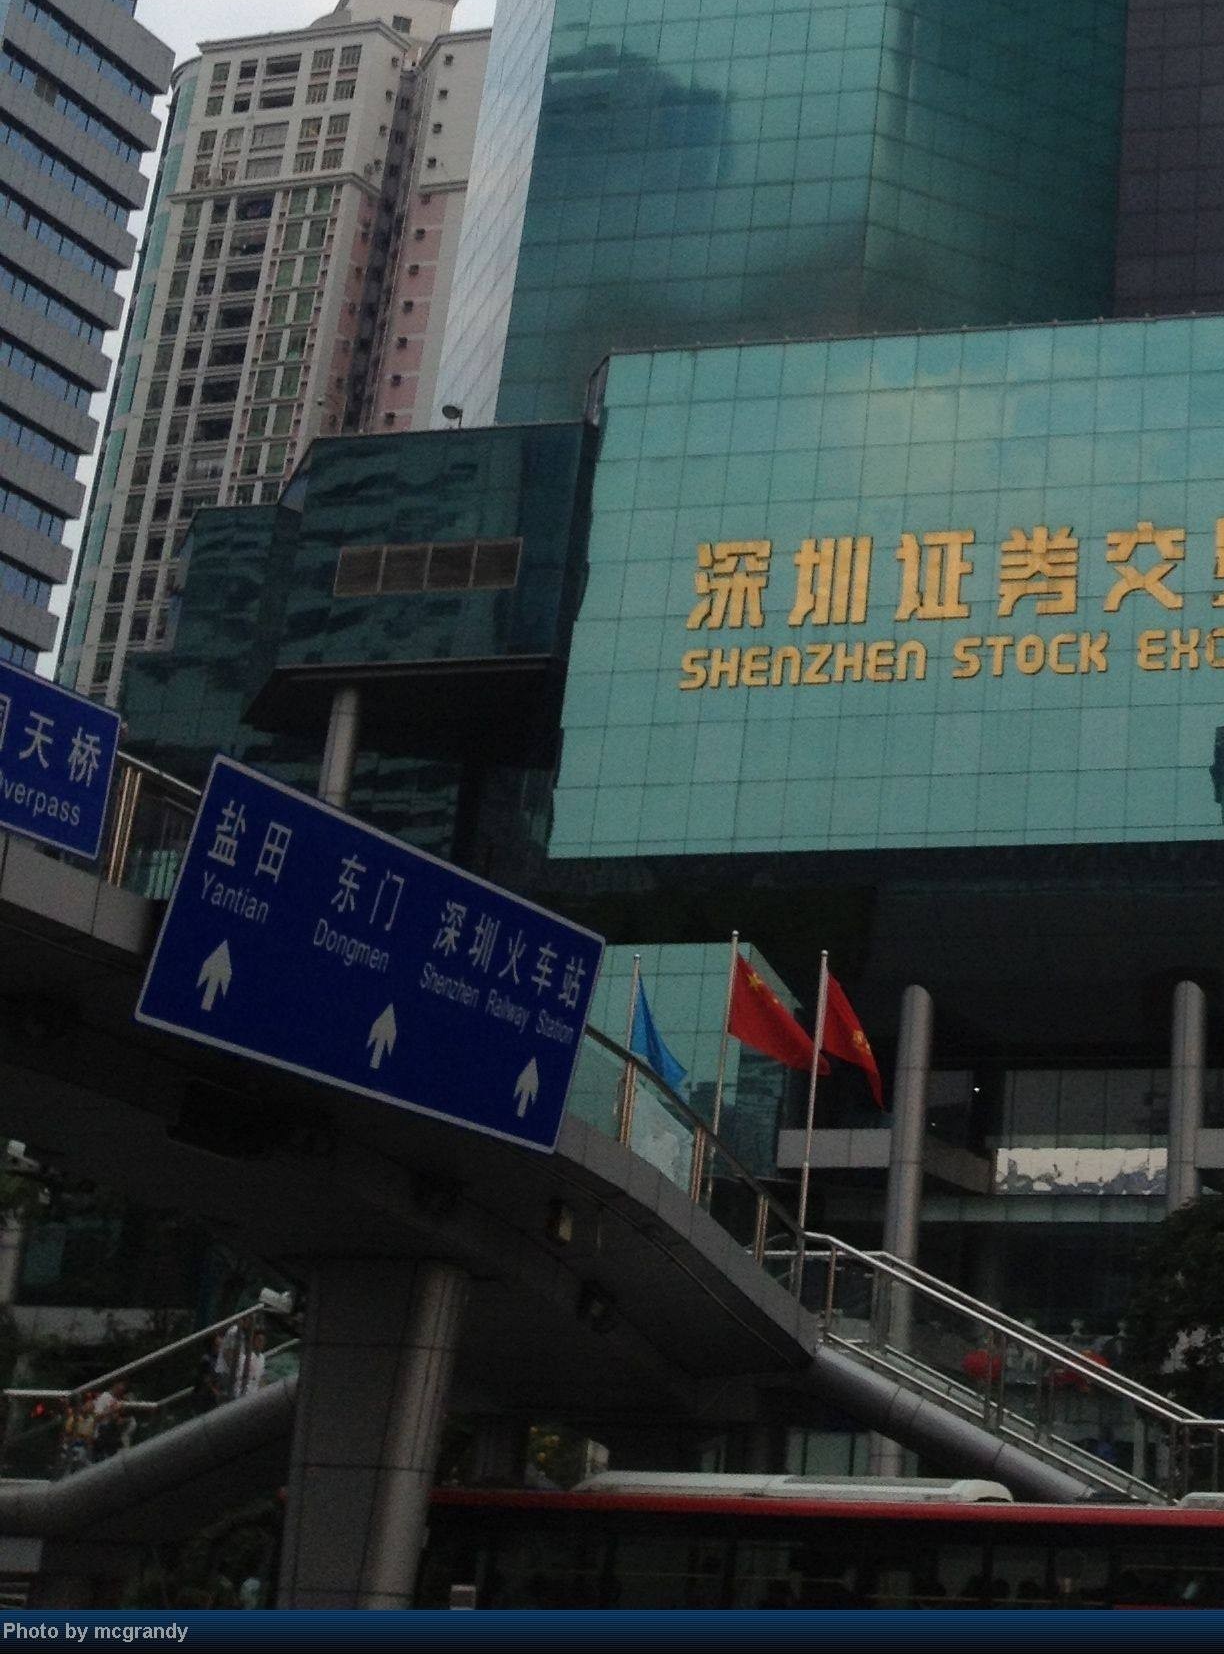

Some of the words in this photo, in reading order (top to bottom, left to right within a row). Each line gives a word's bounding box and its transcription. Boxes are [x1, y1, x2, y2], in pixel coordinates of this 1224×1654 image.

[679, 638, 927, 690] SHENZHEN
[952, 631, 1109, 679] STOCK
[0, 771, 81, 826] verpass
[207, 800, 292, 884] 盐田
[201, 871, 269, 923] Yantian
[330, 854, 405, 932] 东门
[313, 917, 390, 974] Dongmen
[432, 901, 586, 1010] 深圳火车站
[420, 962, 480, 1008] Shenzhen
[485, 988, 531, 1034] Railway
[536, 1008, 575, 1044] Station
